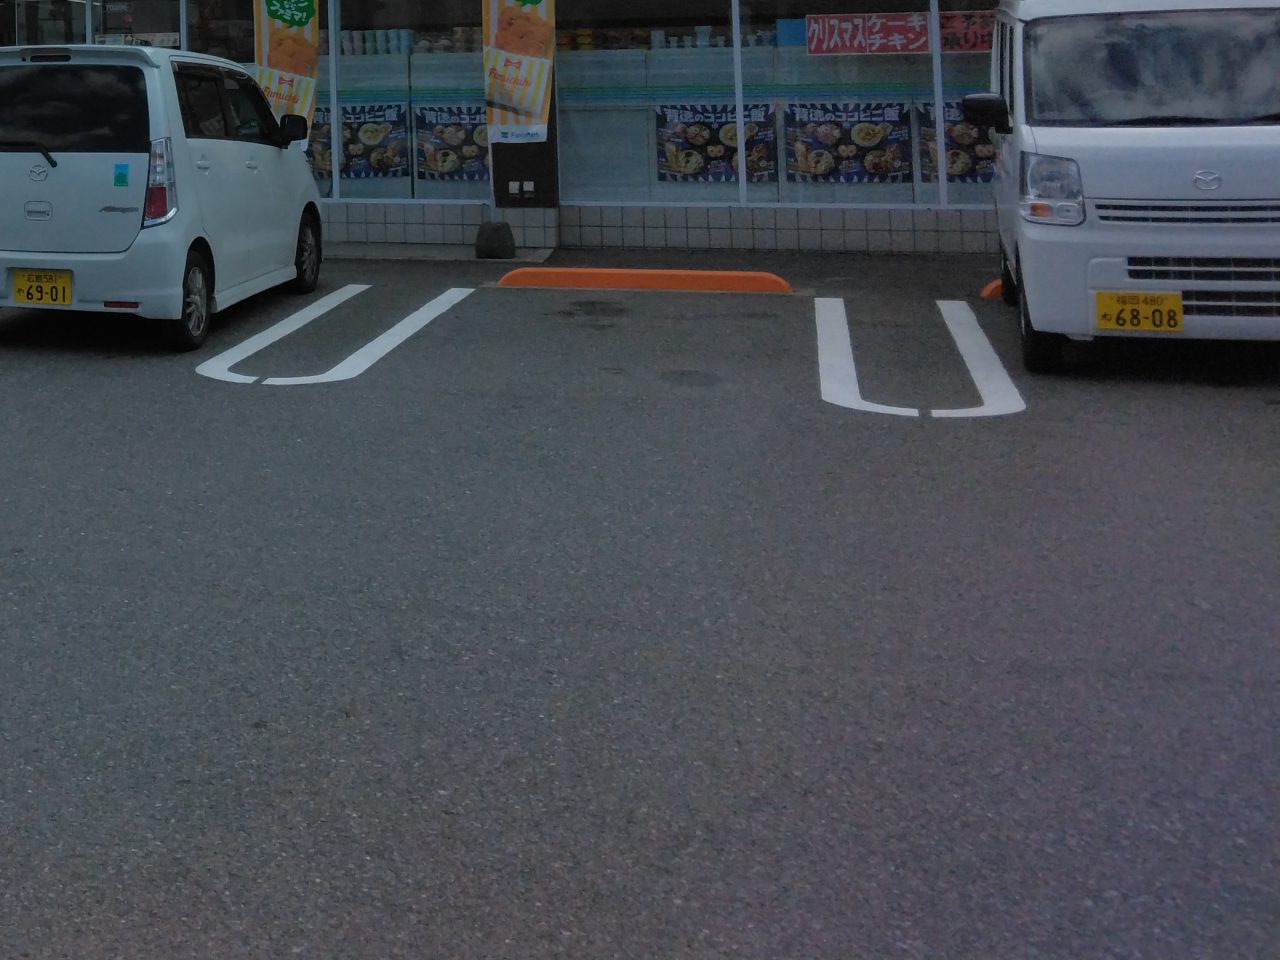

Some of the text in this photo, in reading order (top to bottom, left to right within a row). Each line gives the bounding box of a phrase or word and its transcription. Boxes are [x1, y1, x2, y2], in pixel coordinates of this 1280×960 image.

[868, 15, 926, 32] ケーキ
[808, 17, 866, 51] クリスマス
[869, 33, 927, 50] チキン
[26, 284, 66, 303] 69-01
[1115, 308, 1178, 328] 68-08
